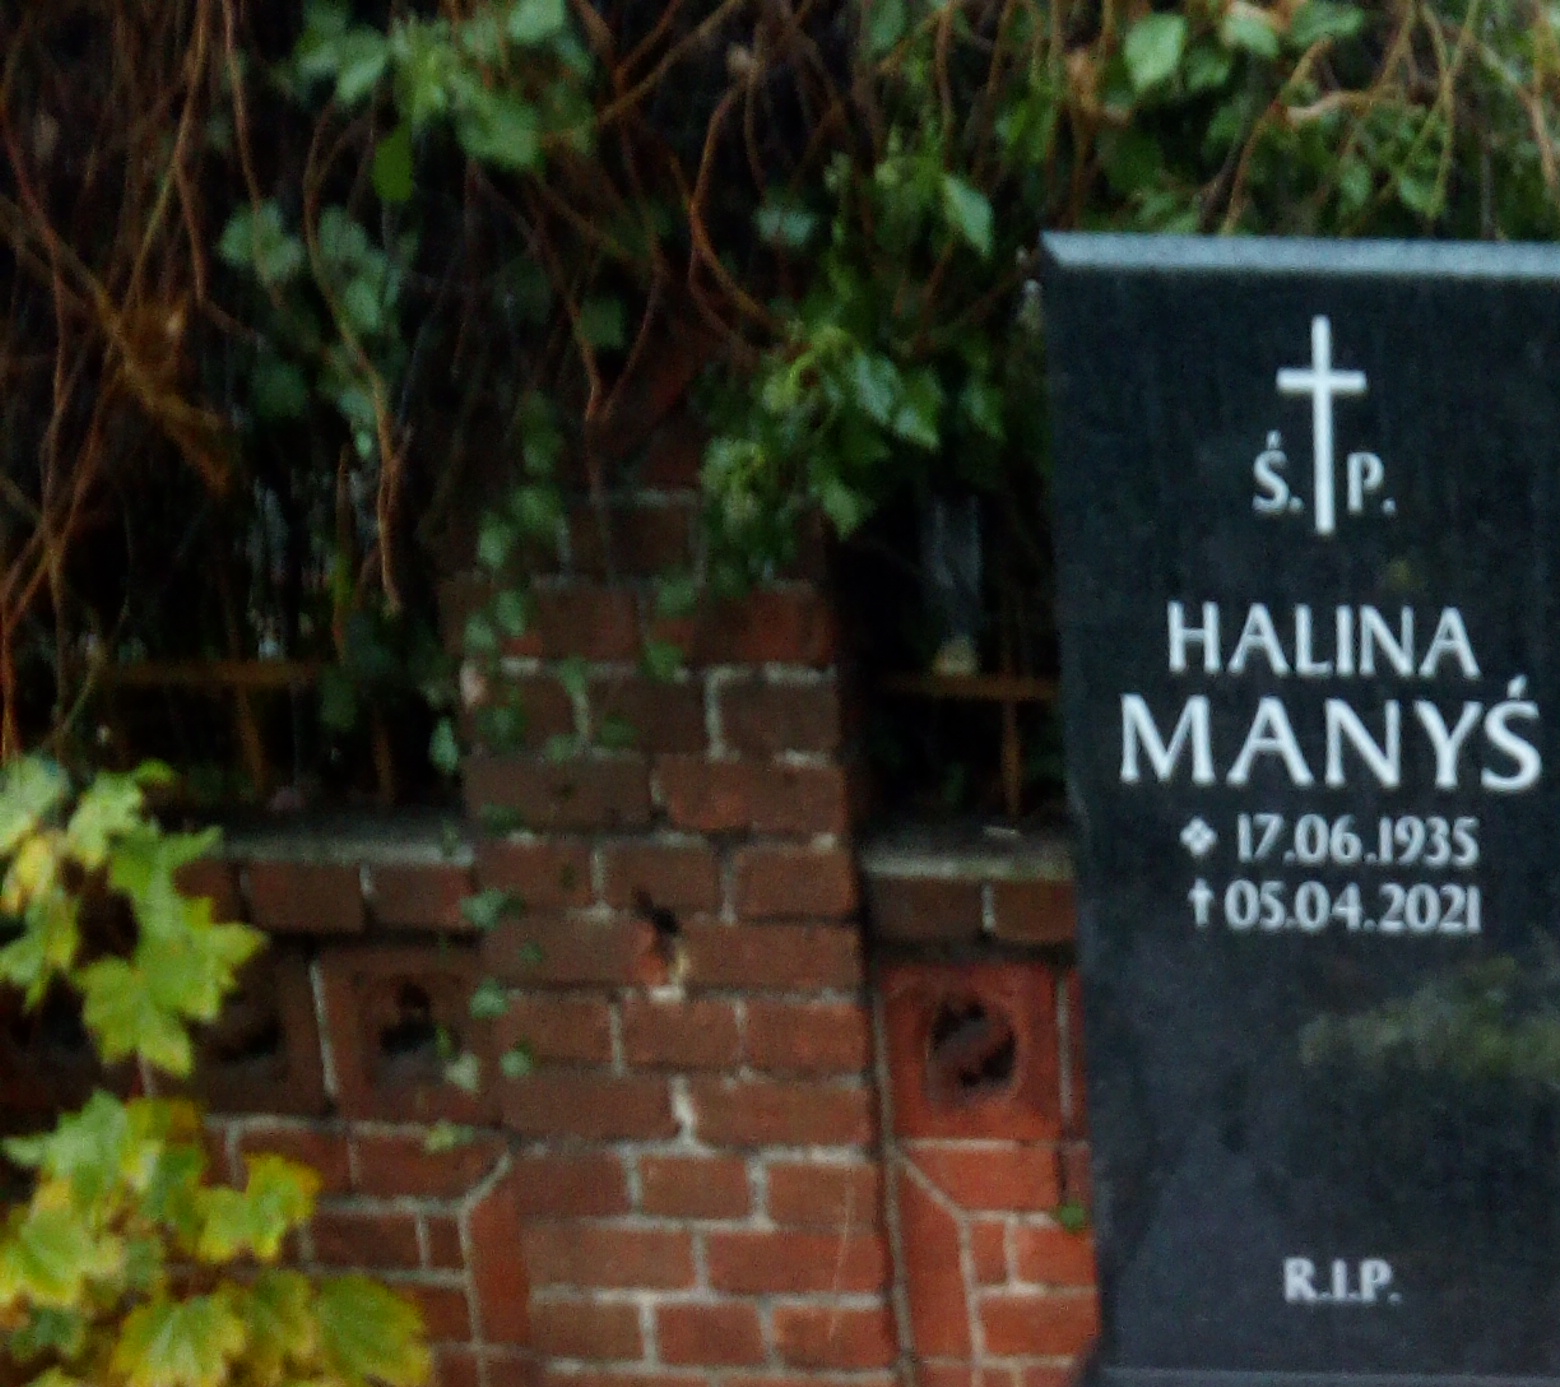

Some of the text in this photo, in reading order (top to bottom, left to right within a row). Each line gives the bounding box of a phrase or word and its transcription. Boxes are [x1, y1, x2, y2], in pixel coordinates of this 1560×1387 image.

[1252, 430, 1396, 514] Ś. P.
[1166, 601, 1482, 679] HALINA
[1119, 674, 1543, 791] MANYŚ
[1236, 812, 1480, 867] 17.06.1935
[1223, 878, 1481, 935] 05.04.2021
[1282, 1256, 1401, 1305] R.I.P.
